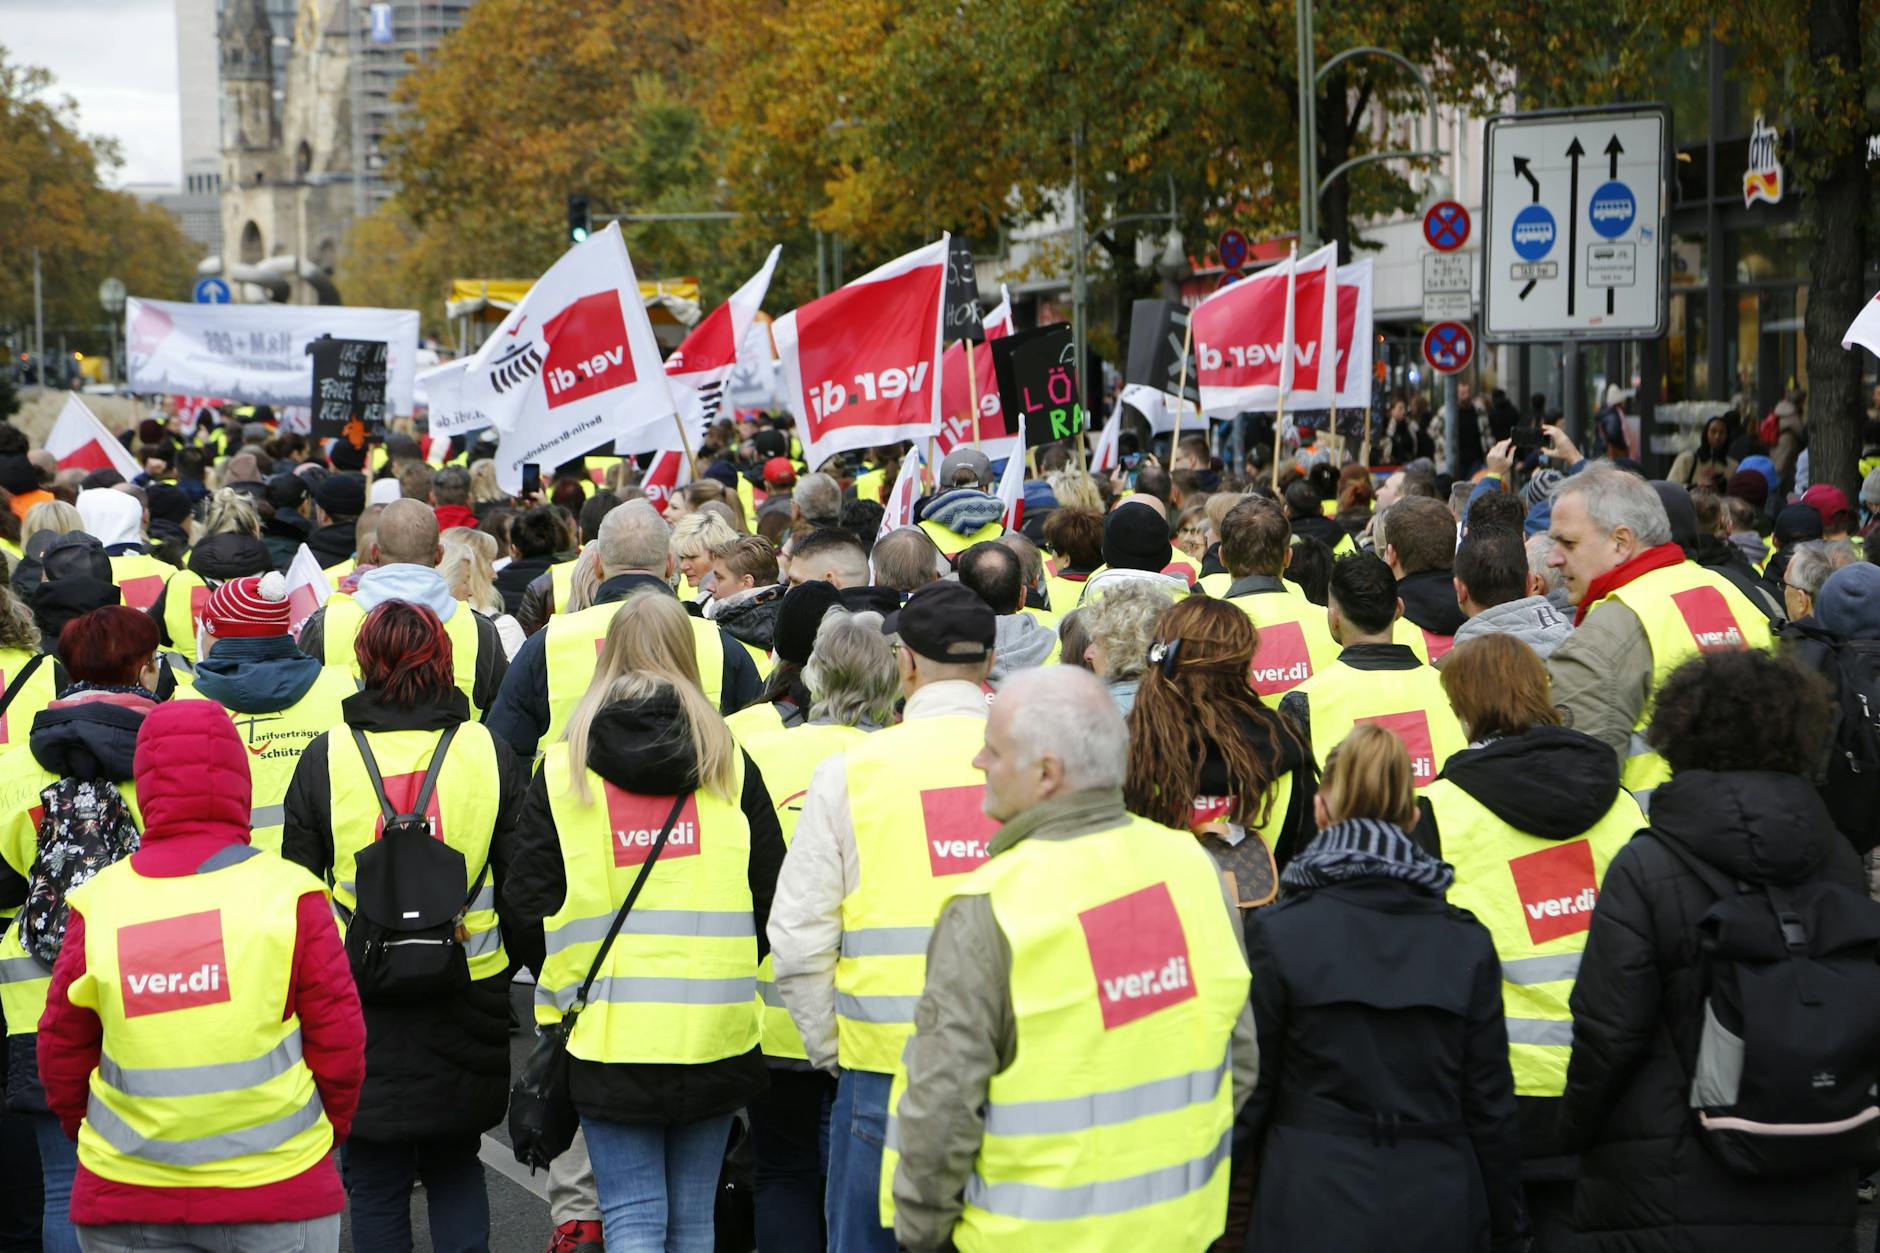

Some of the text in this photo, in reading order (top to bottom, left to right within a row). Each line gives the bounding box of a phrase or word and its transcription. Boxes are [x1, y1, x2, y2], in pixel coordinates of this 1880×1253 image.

[1023, 367, 1081, 413] LÖ
[1253, 662, 1308, 682] ver.di
[260, 747, 304, 760] schütz
[932, 839, 992, 858] ver.
[1526, 888, 1596, 920] ver.di
[127, 964, 219, 995] ver.di
[1103, 956, 1188, 1002] ver.di
